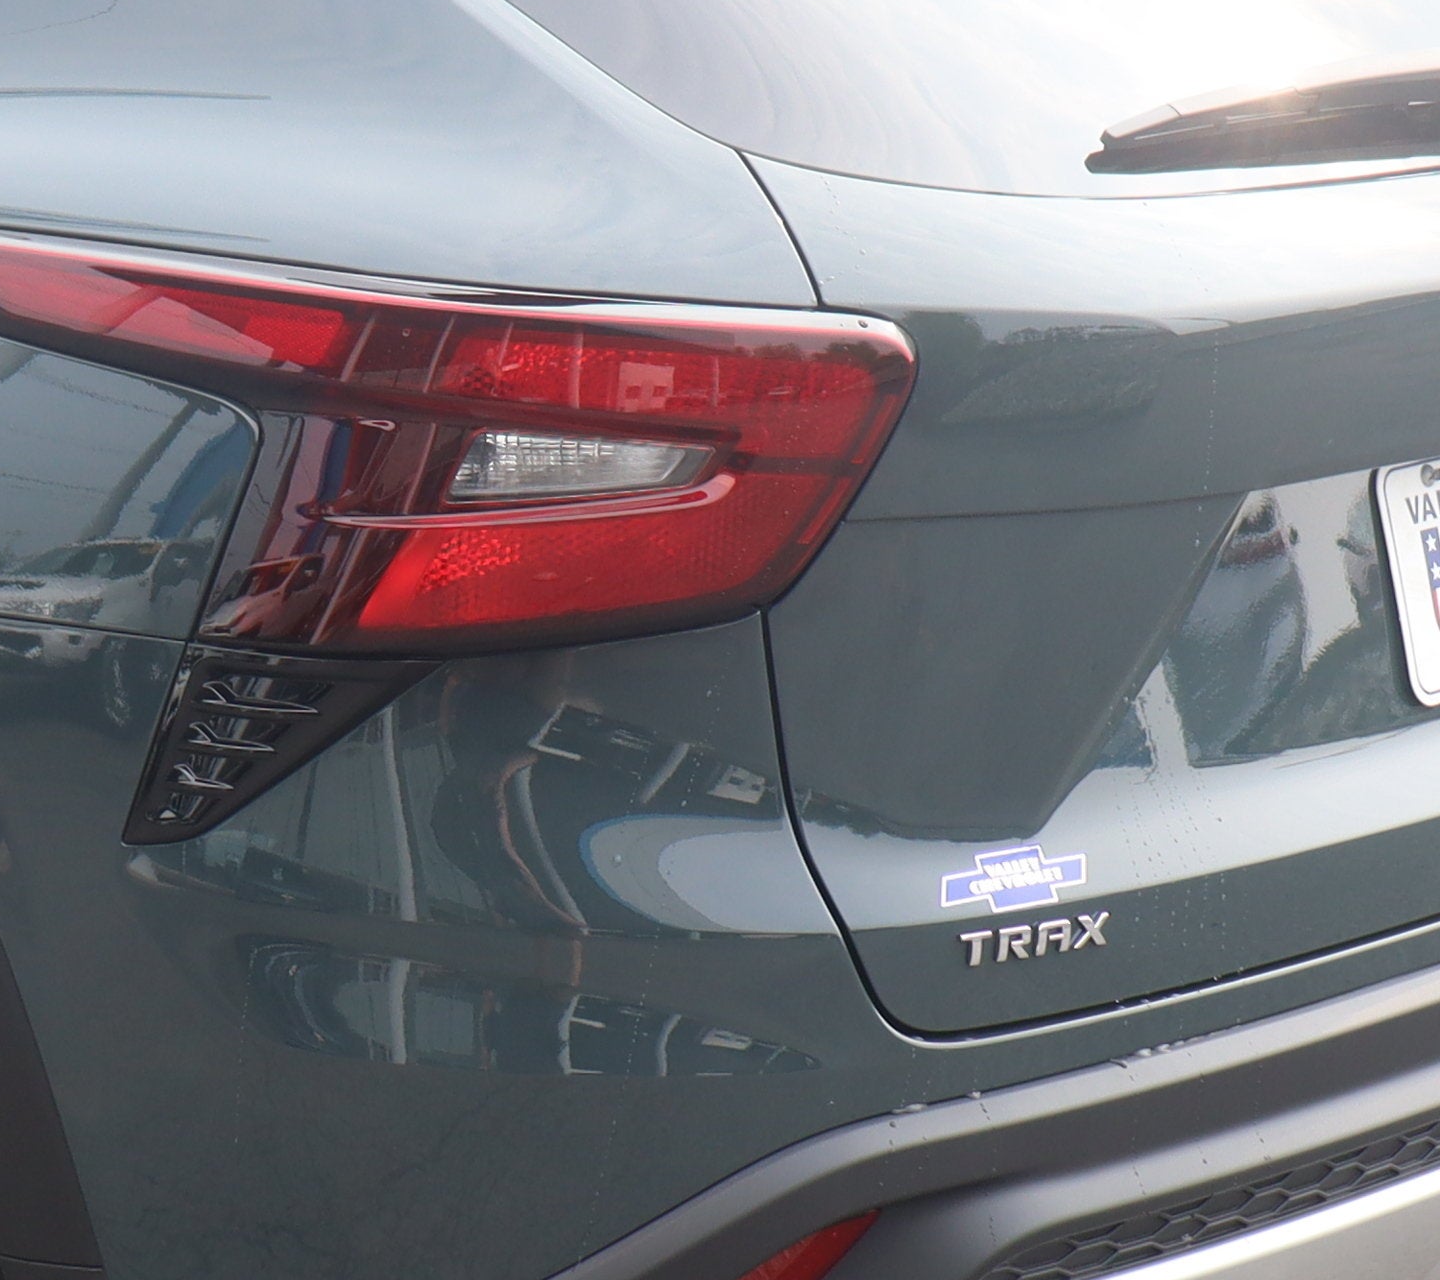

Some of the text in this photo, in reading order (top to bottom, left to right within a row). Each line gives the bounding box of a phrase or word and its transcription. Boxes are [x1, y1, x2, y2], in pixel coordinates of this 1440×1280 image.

[969, 866, 1063, 895] CHEVROLET
[983, 856, 1040, 879] VALLEY
[960, 911, 1111, 967] TRAX
